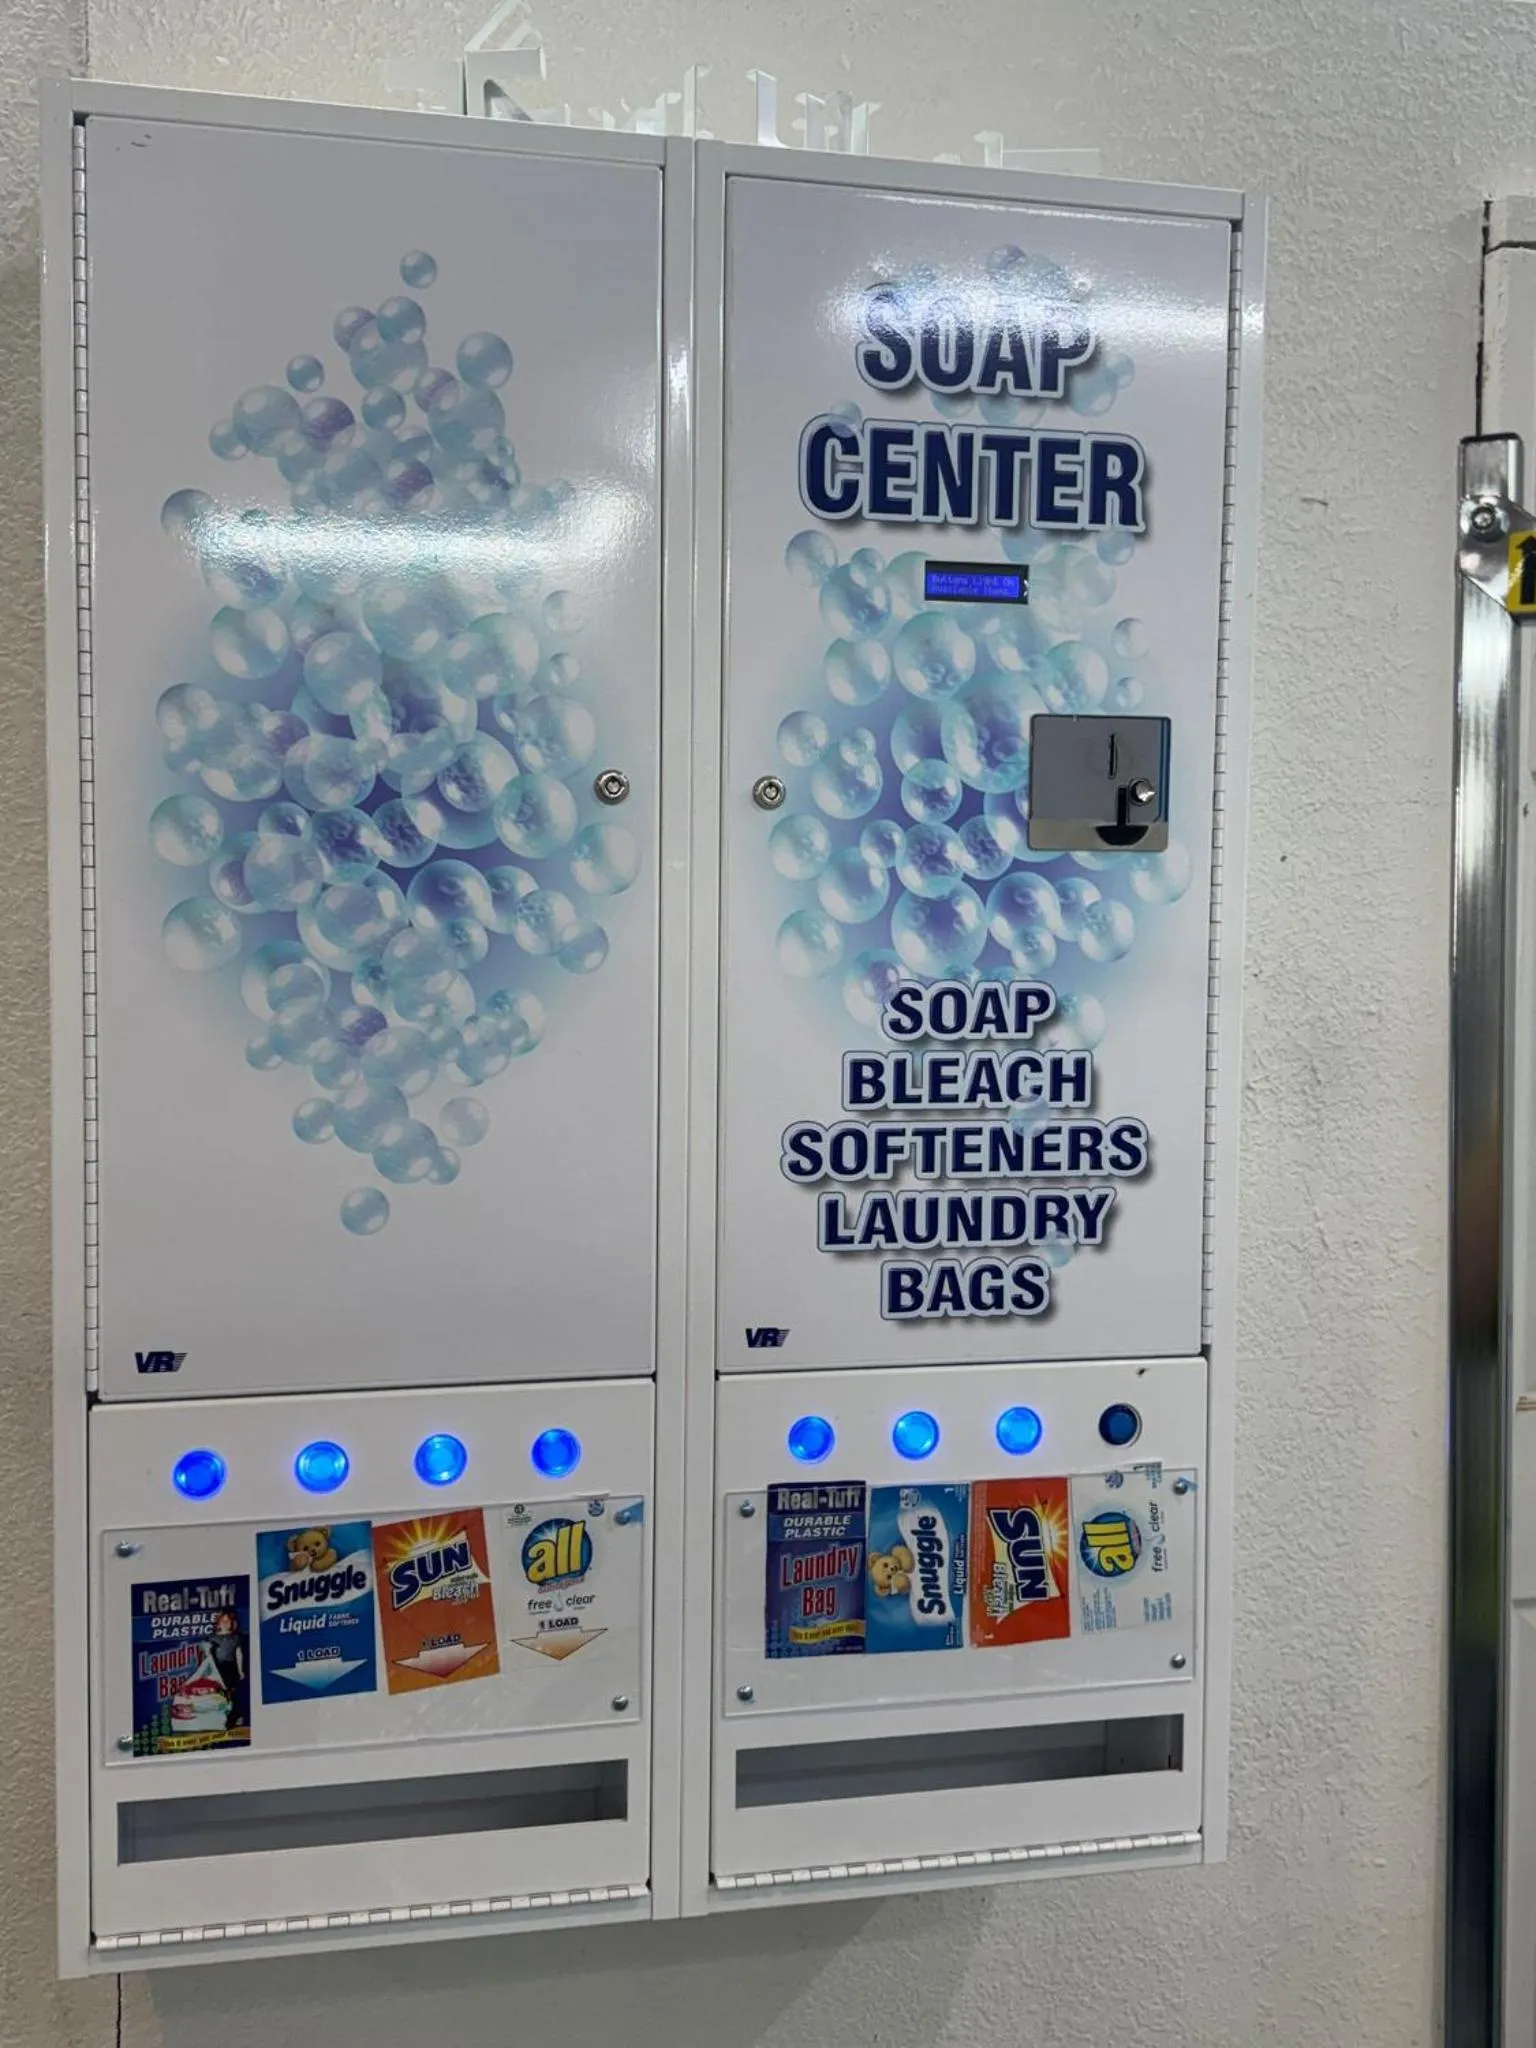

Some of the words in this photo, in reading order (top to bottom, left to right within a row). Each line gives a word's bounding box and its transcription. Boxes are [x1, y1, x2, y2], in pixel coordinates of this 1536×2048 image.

[860, 286, 1094, 394] SOAP
[803, 419, 1143, 529] CENTER
[885, 983, 1053, 1037] SOAP
[846, 1054, 1089, 1108] BLEACH
[784, 1120, 1146, 1180] SOFTENERS
[821, 1190, 1112, 1249] LAUNDRY
[884, 1260, 1047, 1316] BAGS
[777, 1487, 861, 1511] Real-Tuff
[1149, 1501, 1160, 1533] clear
[783, 1515, 852, 1528] DURABLE
[784, 1526, 846, 1539] PLASTIC
[526, 1520, 586, 1585] all
[911, 1514, 946, 1616] Snuggle
[986, 1508, 1051, 1602] SUN
[1082, 1521, 1136, 1573] all
[1151, 1545, 1164, 1573] free
[389, 1540, 472, 1611] SUN
[780, 1543, 861, 1590] Laundry
[953, 1558, 967, 1595] Liquid
[143, 1584, 236, 1614] Real-Tuff
[266, 1564, 367, 1611] Snuggle
[527, 1599, 553, 1612] free
[565, 1594, 597, 1607] clear
[802, 1585, 837, 1618] Bag
[151, 1611, 218, 1628] DURABLE
[152, 1623, 214, 1640] PLASTIC
[279, 1612, 327, 1635] Liquid
[547, 1617, 580, 1630] LOAD
[306, 1645, 341, 1660] LOAD
[429, 1633, 462, 1649] LOAD
[139, 1642, 205, 1680] Laundry
